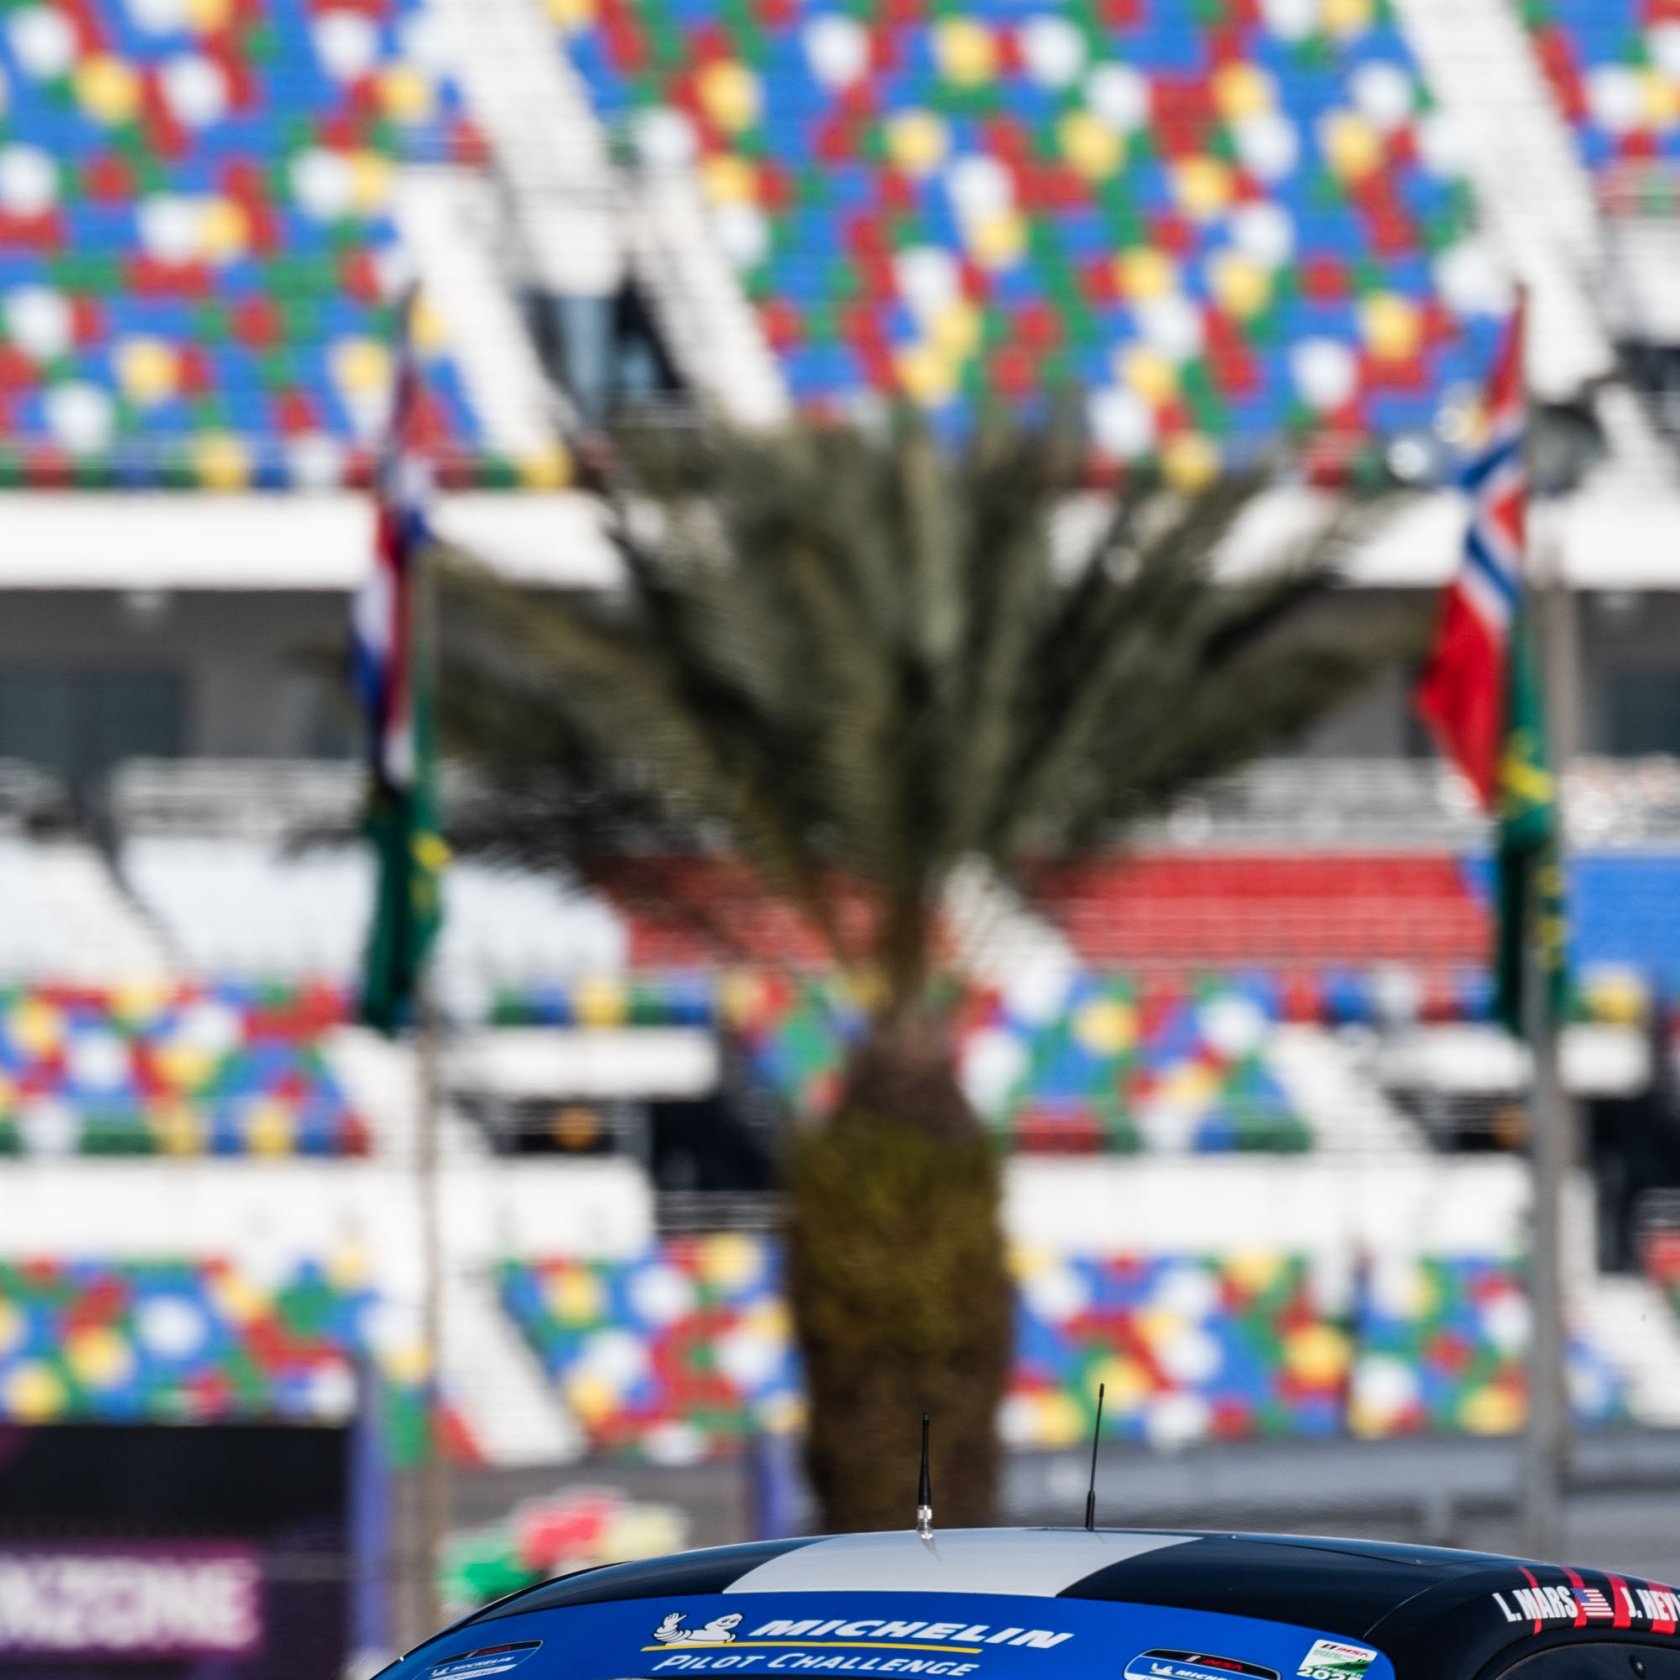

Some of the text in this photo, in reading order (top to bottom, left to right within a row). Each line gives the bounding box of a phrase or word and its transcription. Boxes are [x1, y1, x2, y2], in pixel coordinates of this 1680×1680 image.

[1513, 1586, 1578, 1620] MARS
[750, 1619, 1075, 1649] MICHELIN
[653, 1653, 980, 1677] PILOT CHALLENGE
[1199, 1657, 1244, 1671] IMSA
